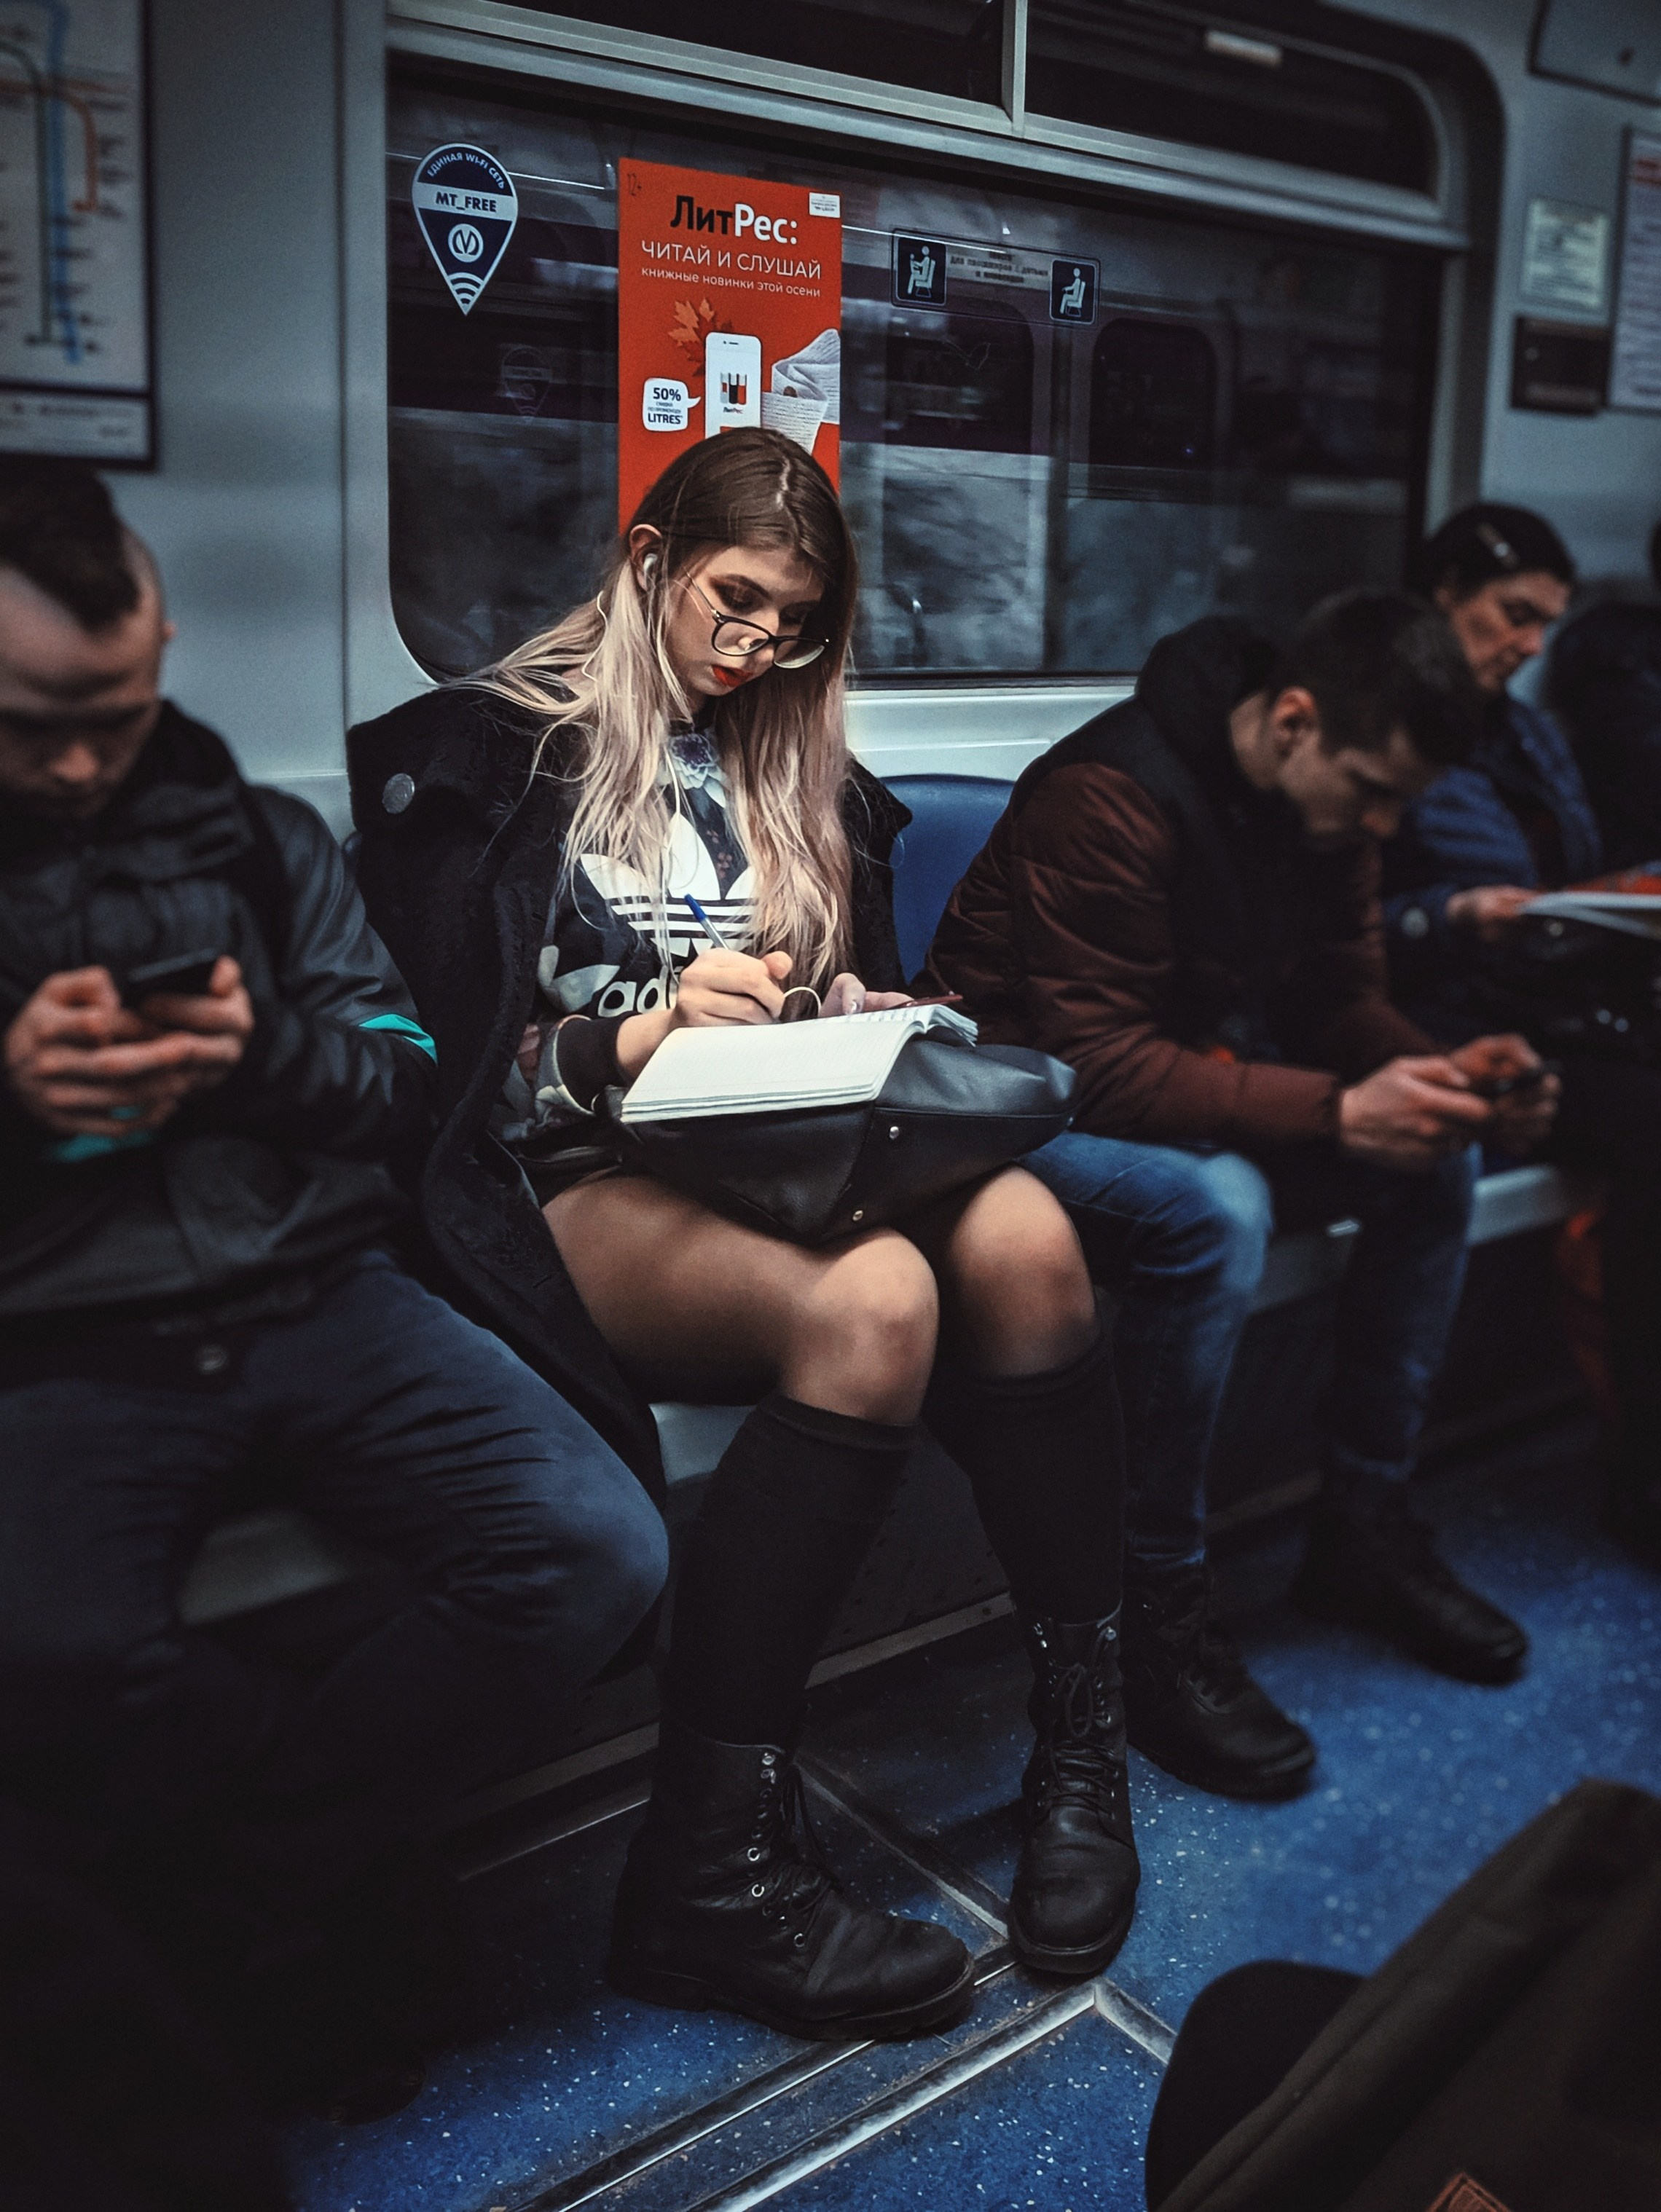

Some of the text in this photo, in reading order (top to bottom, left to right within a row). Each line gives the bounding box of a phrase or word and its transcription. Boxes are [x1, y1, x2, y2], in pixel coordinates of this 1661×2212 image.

[427, 152, 505, 189] ЕДИНАЯ WI-FI СЕТЬ
[435, 192, 497, 213] MT_FREE
[670, 194, 797, 245] ЛитРес:
[641, 240, 821, 280] ЧИТАЙ И СЛУШАЙ
[641, 267, 821, 298] книжные новинки этой осени
[653, 387, 682, 402] 50%
